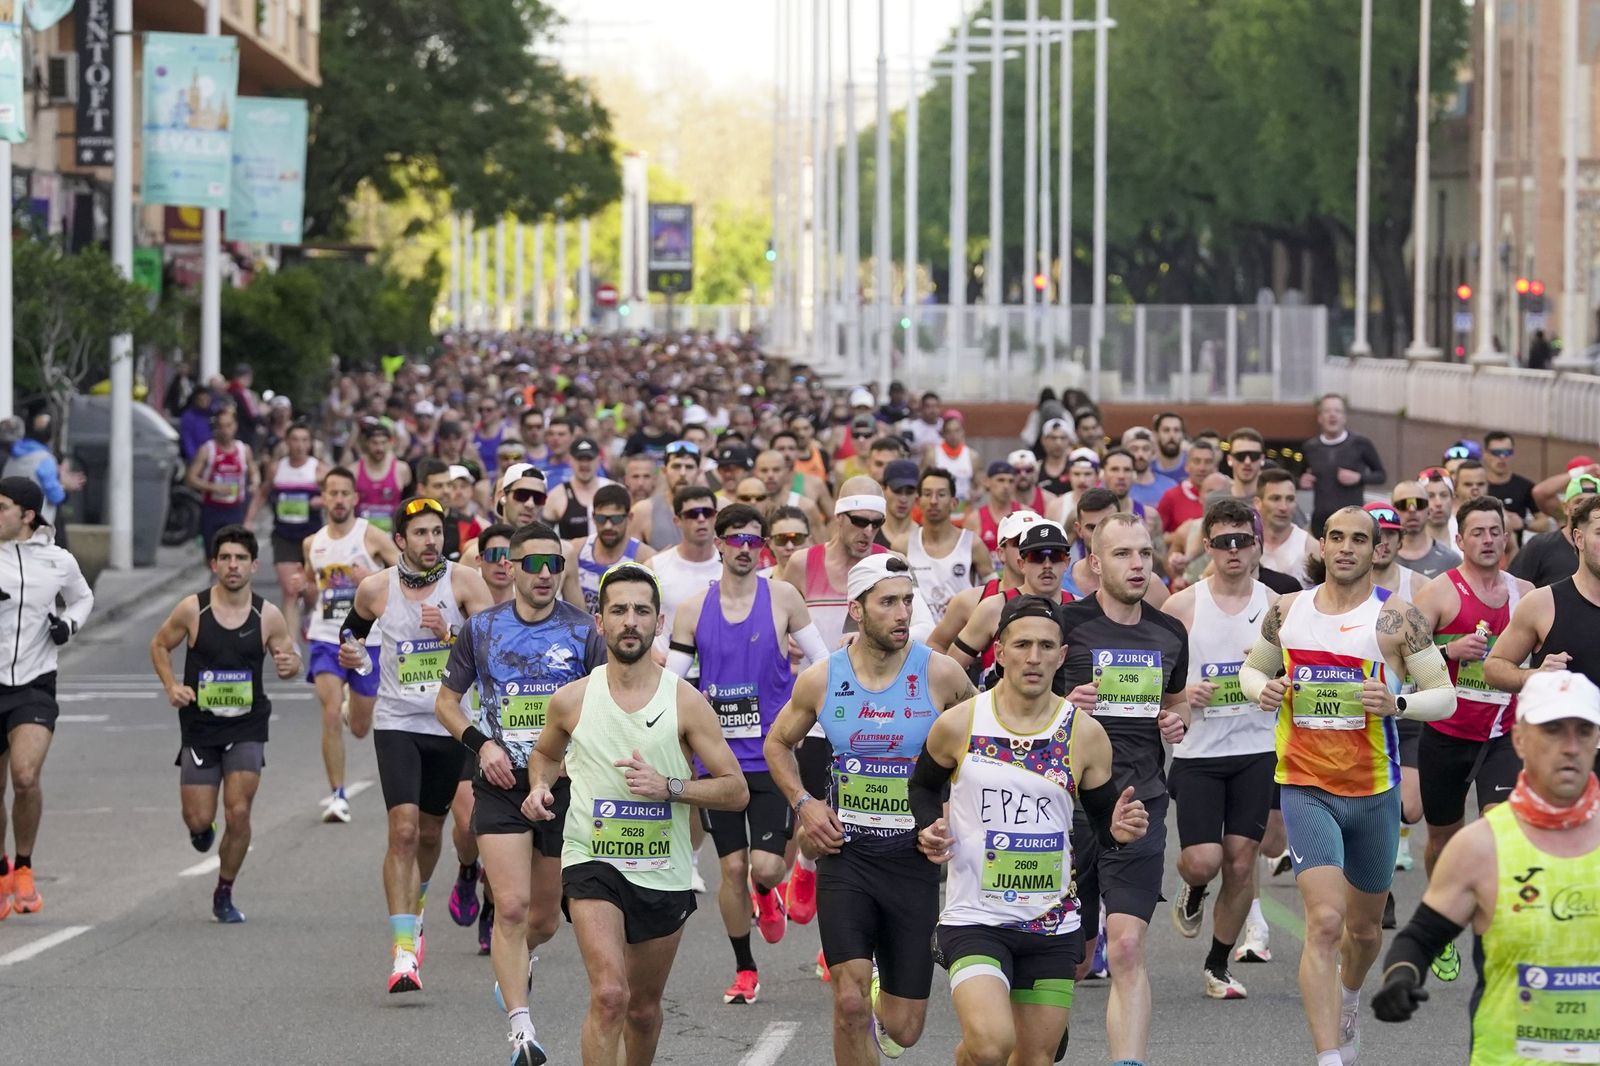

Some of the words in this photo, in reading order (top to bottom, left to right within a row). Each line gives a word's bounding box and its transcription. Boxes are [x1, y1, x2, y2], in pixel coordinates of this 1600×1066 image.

[419, 657, 438, 666] 3182
[1117, 654, 1154, 663] ZURICH
[217, 672, 246, 681] ZURICH
[400, 670, 434, 684] JOANA
[1118, 674, 1139, 683] 2496
[1316, 670, 1355, 680] ZURICH
[523, 683, 558, 693] ZURICH
[1457, 677, 1486, 690] SIMON
[718, 686, 752, 697] ZURICH
[1316, 689, 1338, 698] 2426
[206, 695, 245, 706] VALERO
[1120, 694, 1160, 703] HAVERBEKE
[524, 702, 544, 711] 2197
[1314, 702, 1341, 715] ANY
[858, 706, 896, 719] Petroni
[717, 712, 761, 726] DERICO
[865, 763, 908, 775] ZURICH
[865, 783, 888, 794] 2540
[621, 805, 665, 817] ZURICH
[981, 788, 1052, 825] EPER
[621, 827, 645, 837] 2628
[591, 840, 644, 856] VICTOR
[648, 841, 670, 856] CM
[1015, 838, 1057, 848] ZURICH
[1014, 860, 1038, 870] 2609
[992, 873, 1054, 889] JUANMA
[1555, 1001, 1587, 1015] 2721
